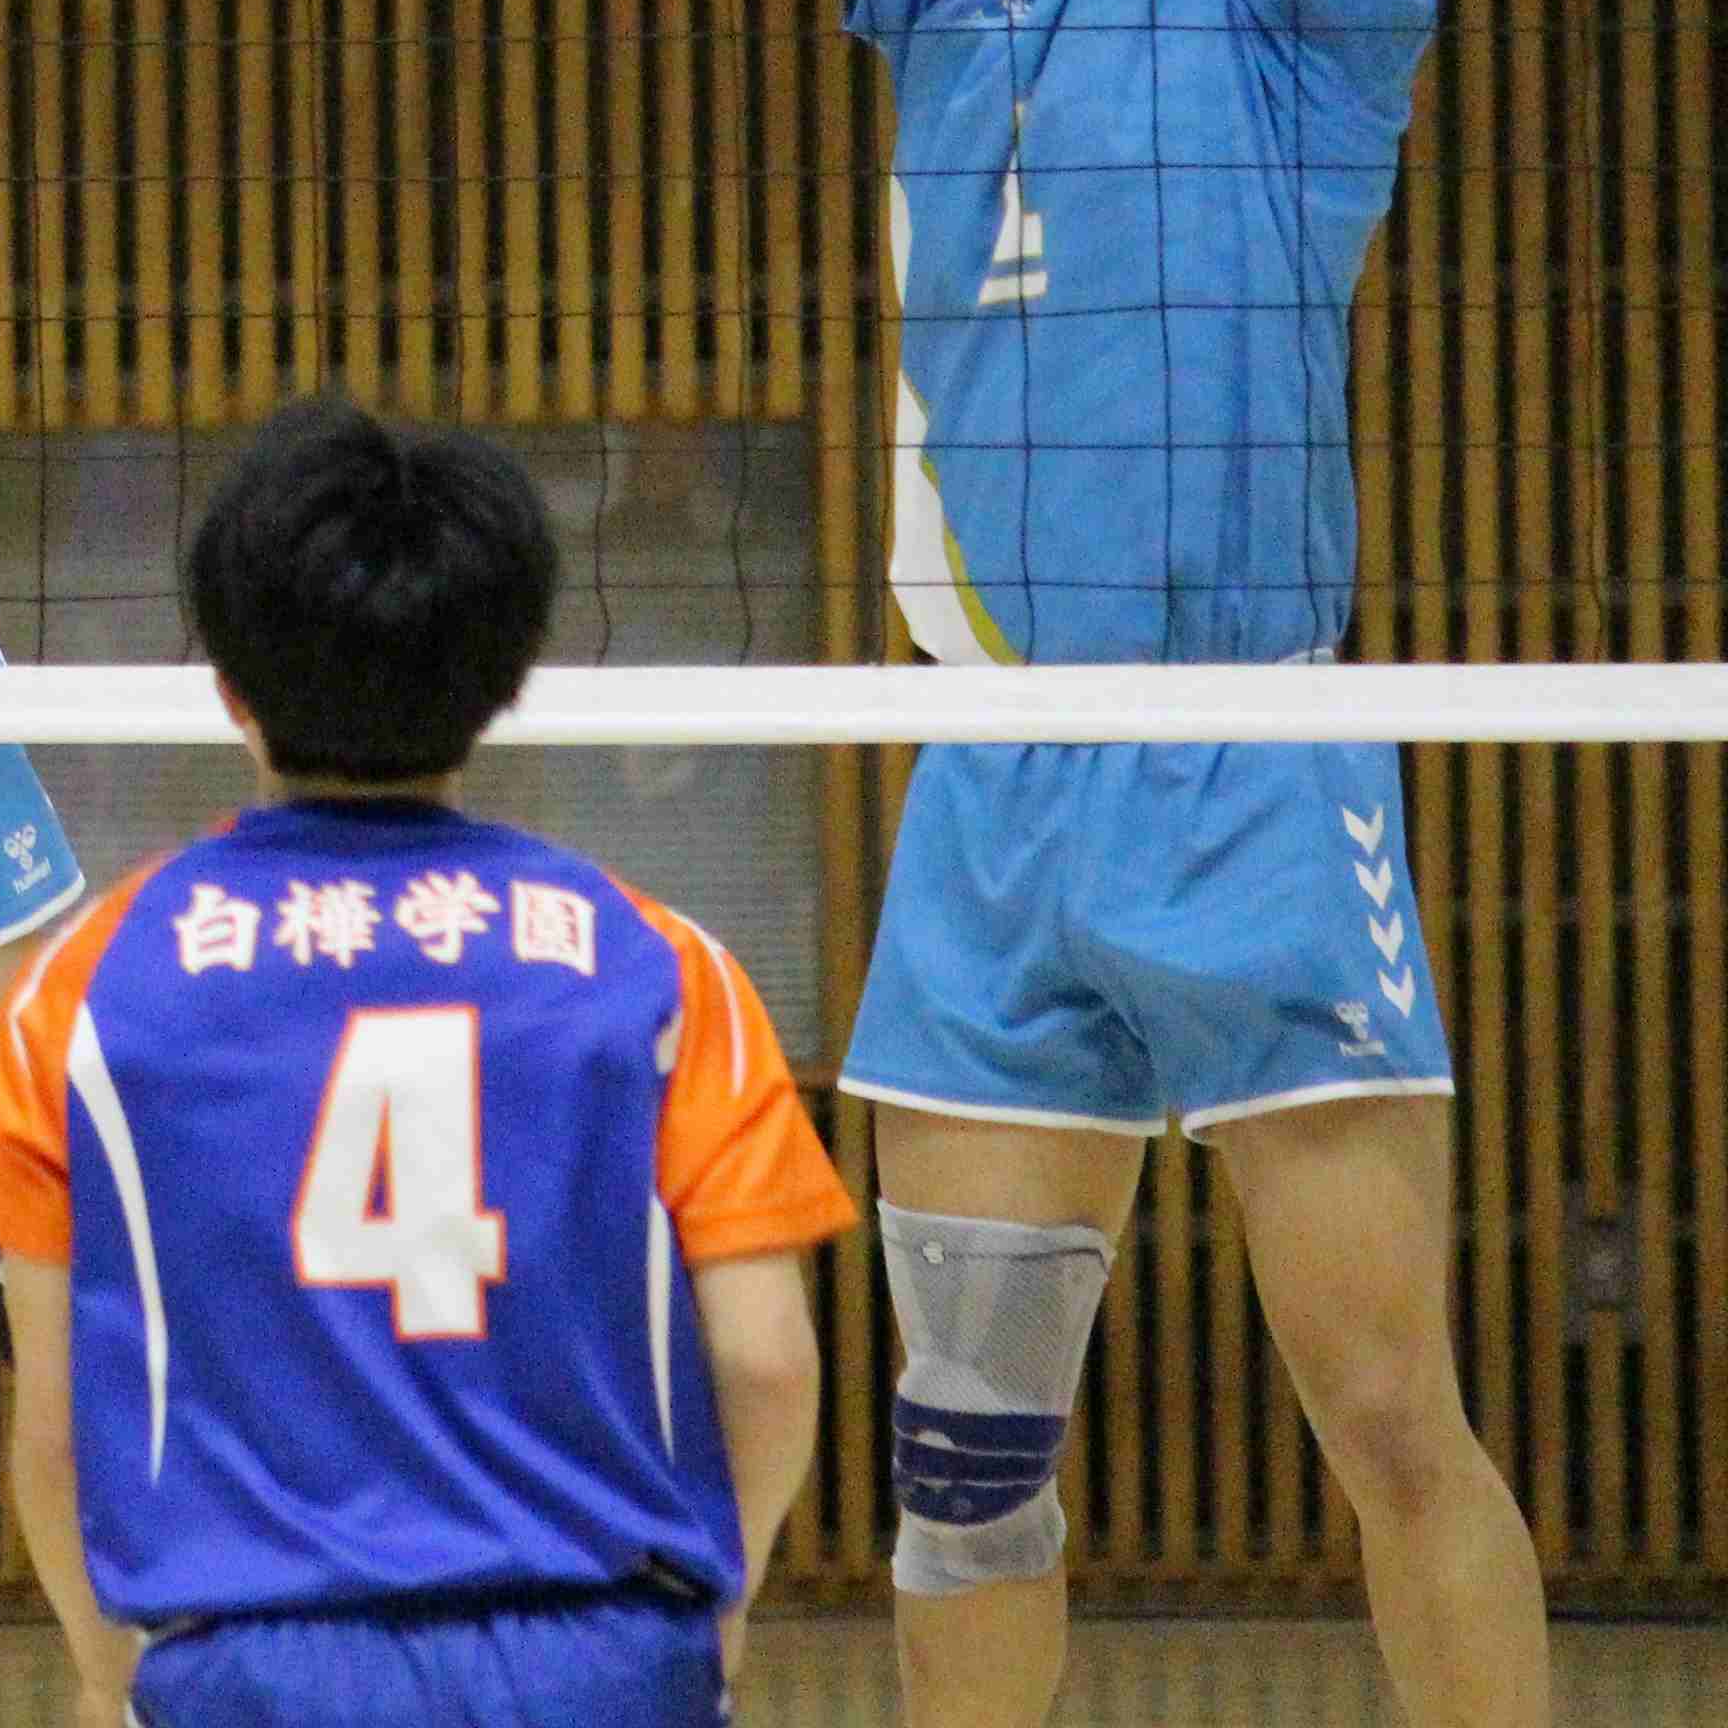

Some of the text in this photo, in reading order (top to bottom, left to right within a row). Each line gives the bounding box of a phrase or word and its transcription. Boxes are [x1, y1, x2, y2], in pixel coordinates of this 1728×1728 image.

[172, 870, 598, 977] 白樺学園
[290, 1001, 508, 1343] 4
